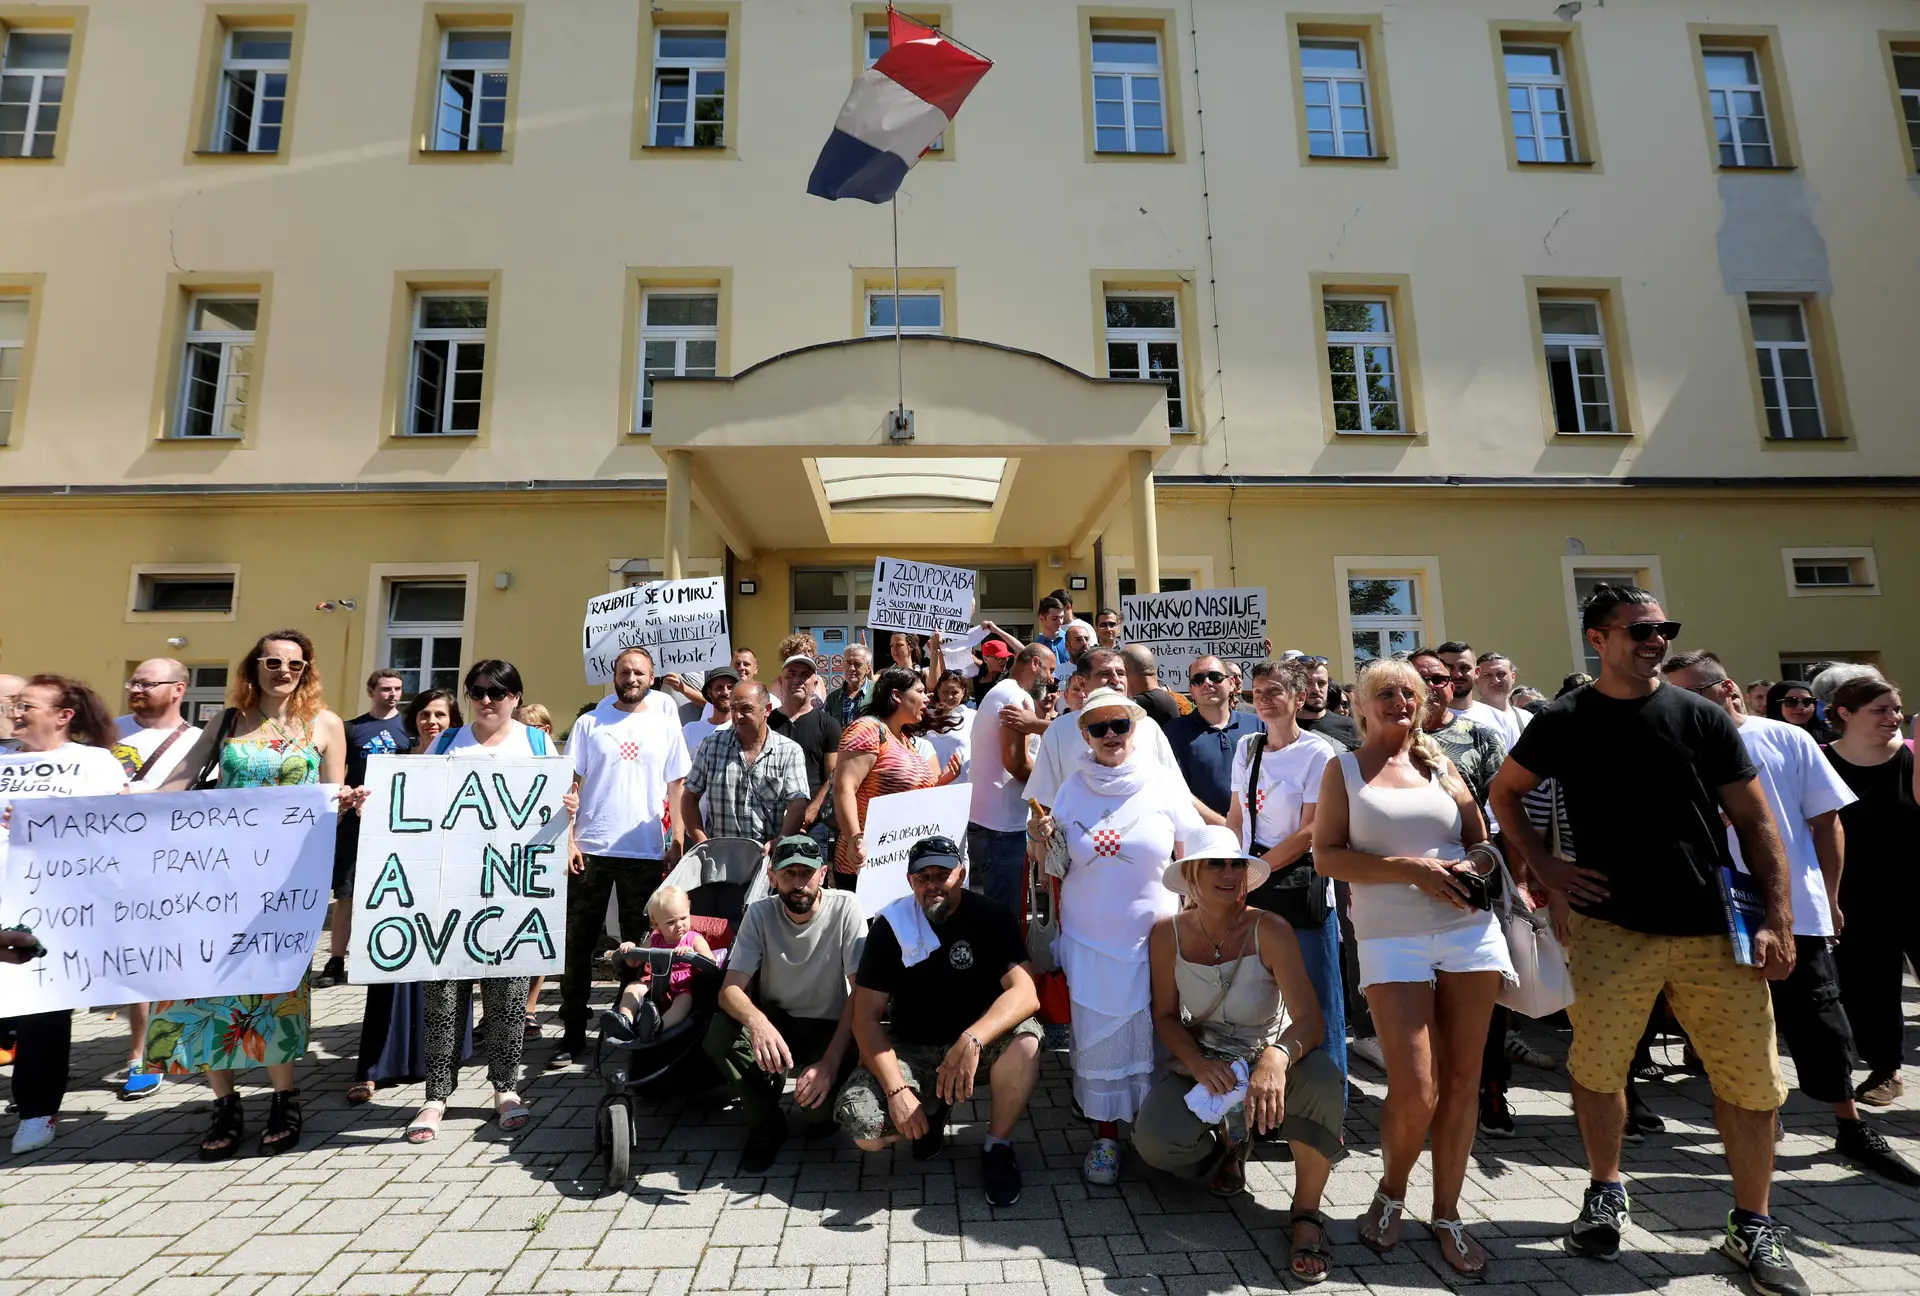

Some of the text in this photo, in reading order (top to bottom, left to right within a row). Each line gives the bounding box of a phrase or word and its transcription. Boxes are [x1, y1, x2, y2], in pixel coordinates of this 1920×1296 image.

[893, 563, 975, 590] ZLOUPORABA
[645, 588, 659, 604] SE
[663, 588, 673, 604] U
[888, 581, 954, 603] INSTITUCIJA
[872, 609, 906, 626] JEDINE
[889, 599, 927, 611] SUSTAVNI
[929, 605, 963, 616] PROGON
[1123, 598, 1192, 622] "NIKAKVO
[592, 612, 714, 635] POZIVANJE NA NASILNO
[1123, 621, 1184, 641] NIKAKVO
[618, 628, 667, 647] RUŠENJE
[1188, 645, 1202, 655] za
[1203, 641, 1267, 657] TERORIZAM
[389, 770, 551, 833] LAV,
[28, 806, 315, 842] MARKO BORAC ZA
[152, 848, 231, 873] PRAVA
[254, 849, 269, 866] U
[366, 843, 555, 909] A NE
[19, 889, 318, 930] OVOM BIOLOŠKOM RATU
[367, 905, 556, 972] OVCA
[102, 943, 183, 977] NEVIN
[200, 940, 213, 963] U
[227, 930, 314, 955] ZATVORU
